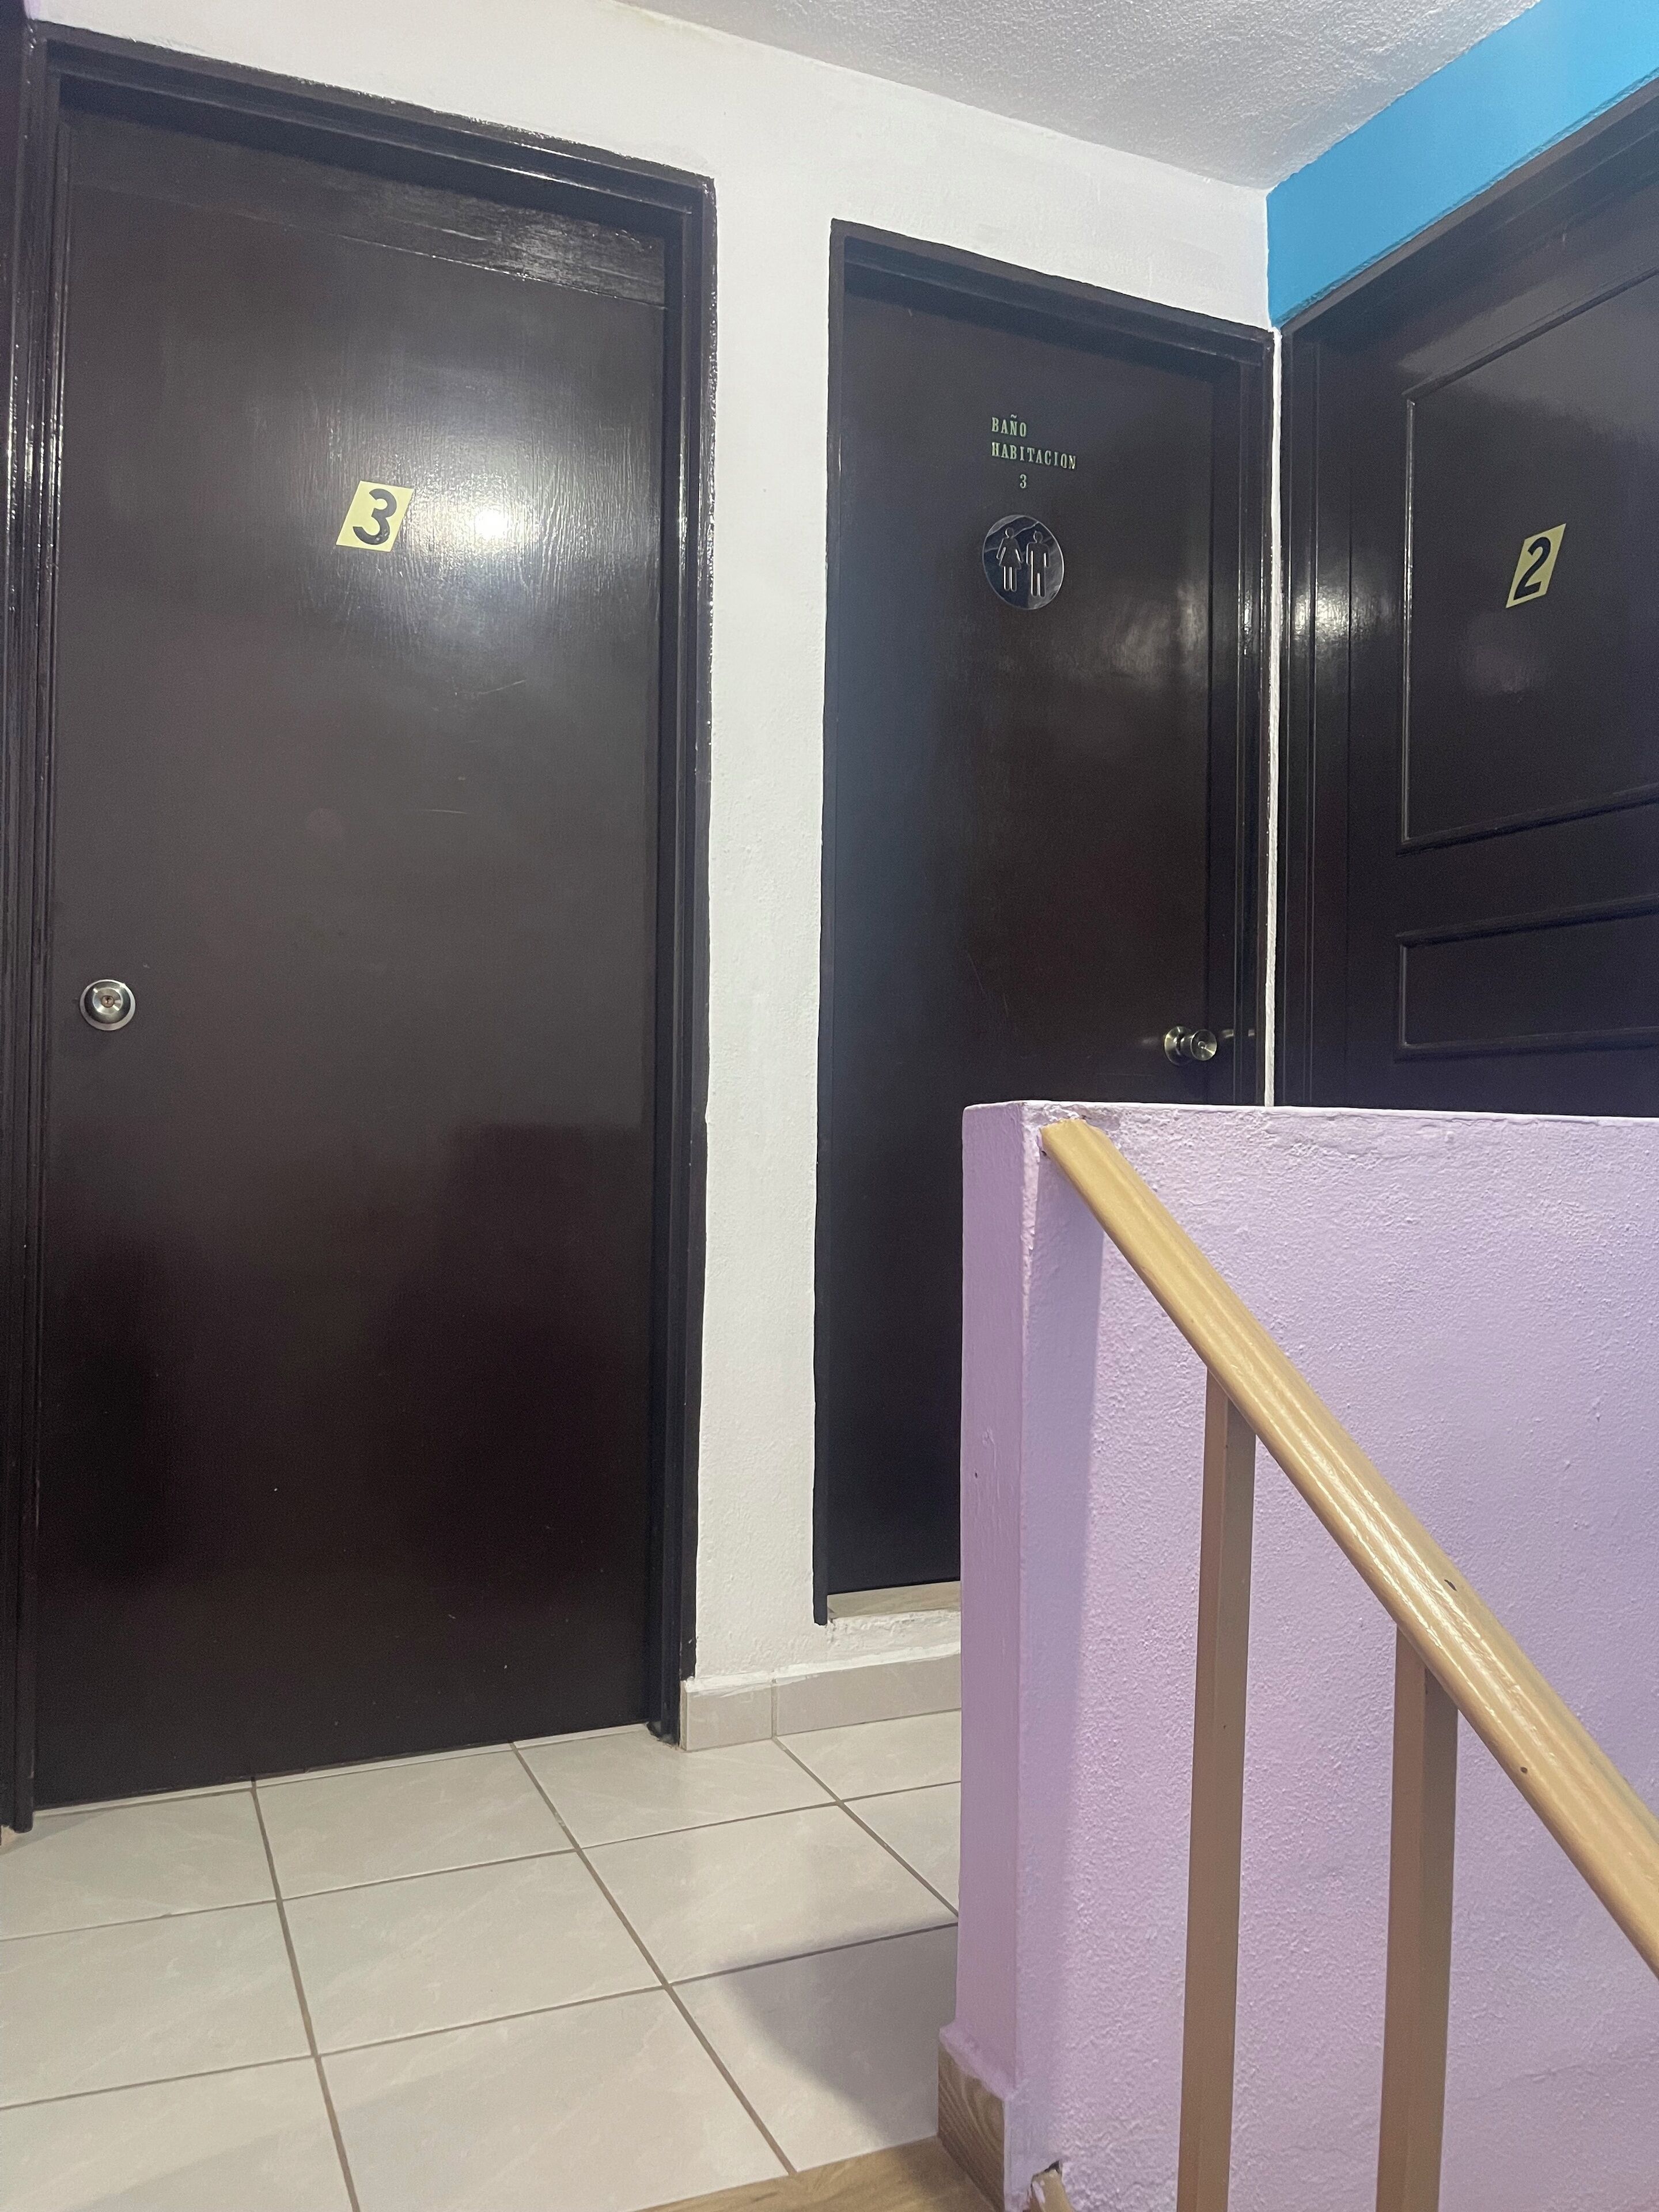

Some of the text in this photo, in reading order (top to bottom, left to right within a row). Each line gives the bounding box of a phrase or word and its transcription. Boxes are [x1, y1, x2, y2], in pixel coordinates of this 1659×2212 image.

[991, 414, 1027, 437] BAÑO
[991, 441, 1077, 469] HABITACION
[1019, 474, 1027, 488] 3
[353, 488, 397, 545] 3
[1513, 536, 1551, 600] 2
